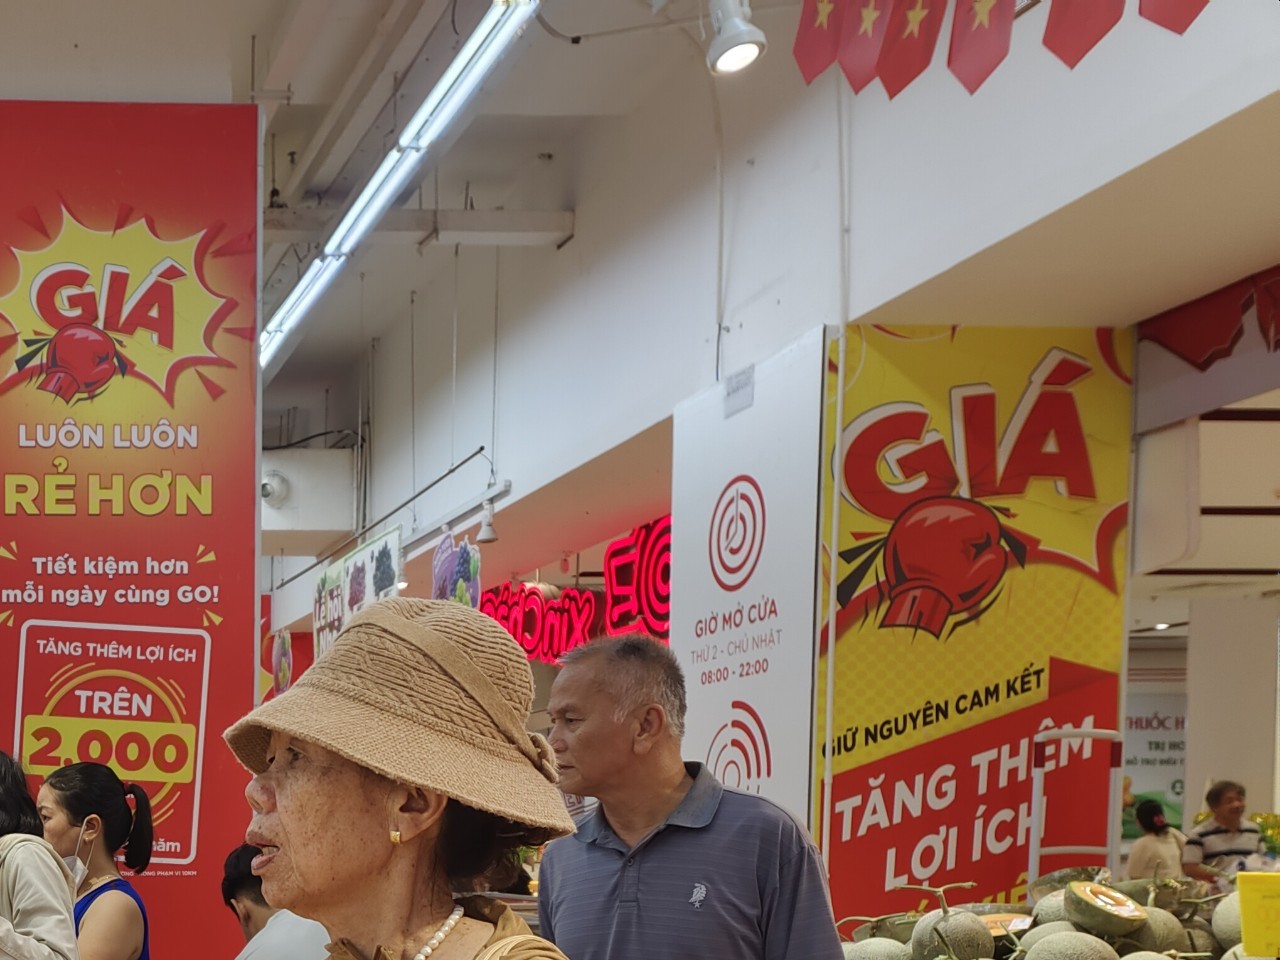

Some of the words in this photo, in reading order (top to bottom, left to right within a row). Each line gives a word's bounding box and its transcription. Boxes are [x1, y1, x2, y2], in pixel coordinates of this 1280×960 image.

[31, 257, 188, 351] GIÁ
[18, 417, 104, 448] LUÔN
[113, 417, 199, 448] LUÔN
[834, 347, 1098, 521] GIÁ
[4, 456, 77, 516] RẺ
[88, 469, 214, 516] HƠN
[32, 553, 78, 575] Tiết
[84, 556, 139, 580] kiệm
[145, 556, 189, 575] hơn
[1, 580, 44, 603] mỗi
[51, 584, 107, 607] ngày
[114, 585, 170, 607] cùng
[177, 585, 220, 603] GO!
[694, 611, 719, 638] GIỜ
[722, 601, 745, 632] MỞ
[748, 594, 778, 624] CỬA
[36, 637, 83, 656] TĂNG
[86, 640, 133, 660] THÊM
[136, 644, 165, 663] LỢI
[168, 645, 197, 663] ÍCH
[690, 643, 711, 664] THỨ
[711, 645, 718, 660] 2
[727, 632, 749, 657] CHỦ
[751, 628, 783, 651] NHẬT
[700, 666, 729, 686] 08:00
[739, 657, 769, 678] 22:00
[74, 686, 152, 717] TRÊN
[822, 727, 859, 759] GIỮ
[864, 701, 949, 747] NGUYÊN
[955, 683, 1000, 715] CAM
[1006, 662, 1045, 699] KẾT
[28, 726, 189, 775] 2.000
[834, 773, 957, 842] TĂNG
[971, 714, 1095, 796] THÊM
[884, 825, 958, 892] LỢI
[971, 796, 1048, 862] ÍCH
